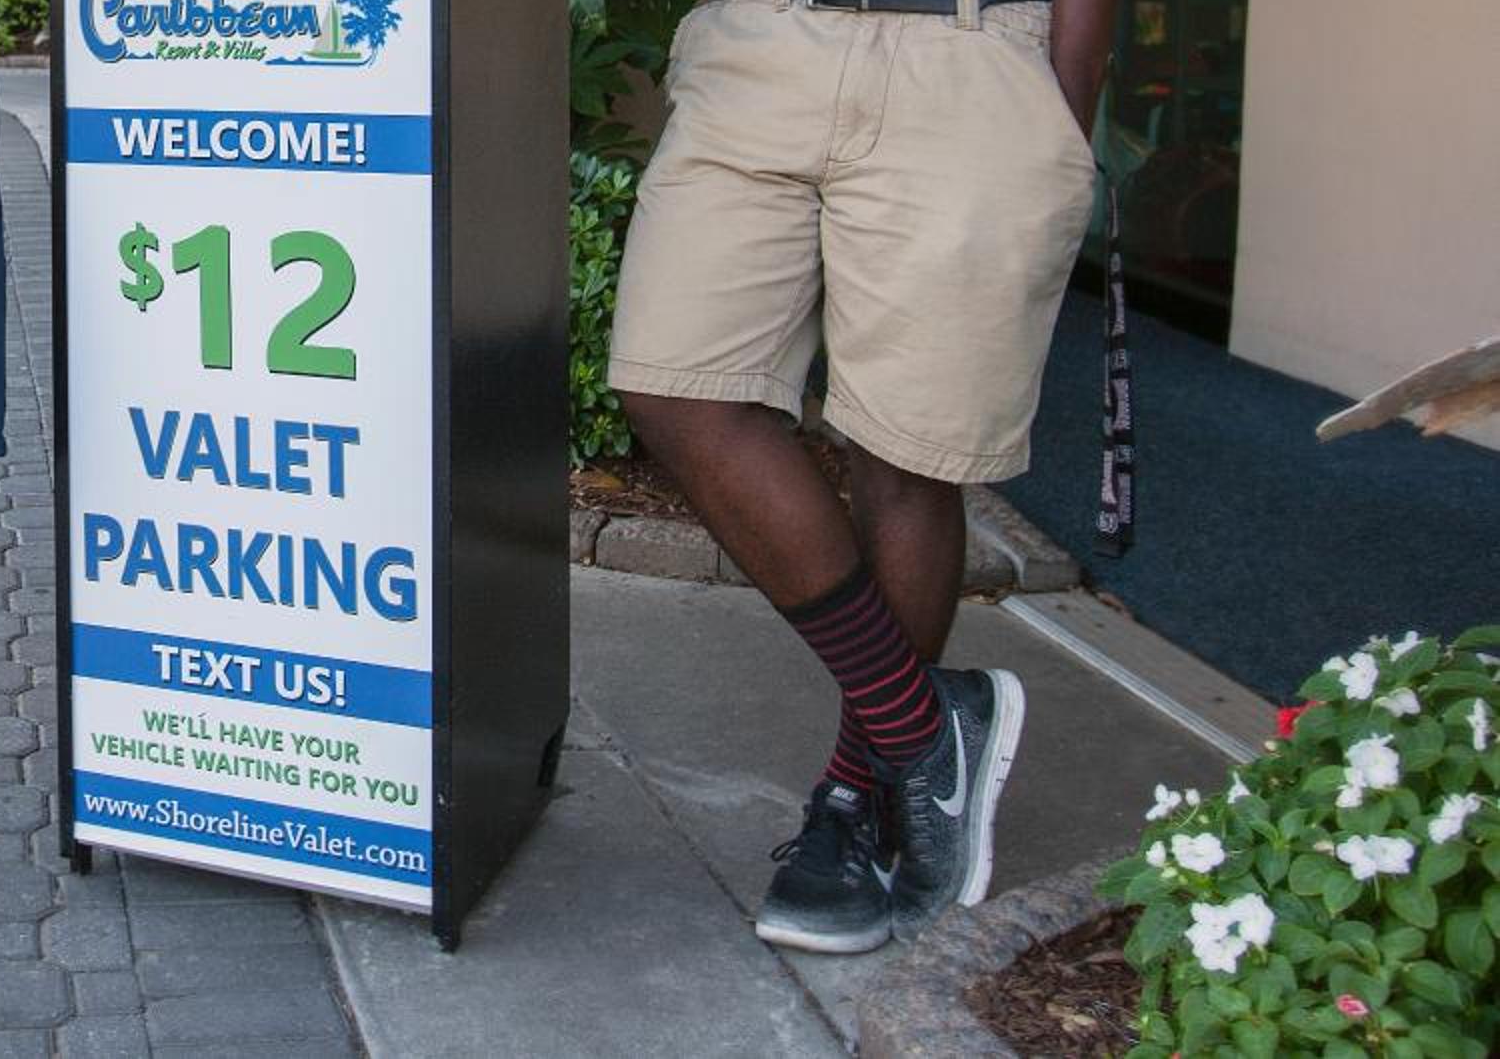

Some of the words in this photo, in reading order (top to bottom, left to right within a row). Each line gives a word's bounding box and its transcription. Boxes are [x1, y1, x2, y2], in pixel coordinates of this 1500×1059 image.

[156, 40, 201, 60] Resort
[203, 41, 220, 59] &
[223, 41, 267, 61] Villas
[112, 117, 367, 164] WELCOME!
[118, 221, 358, 381] $12
[128, 406, 360, 498] VALET
[83, 512, 419, 623] PARKING
[152, 643, 260, 693] TEXT
[274, 662, 347, 707] US!
[90, 732, 186, 768] VEHICLE
[191, 748, 301, 787] WAITING
[309, 768, 358, 798] FOR
[363, 776, 420, 807] YOU
[219, 721, 285, 753] HAVE
[291, 732, 360, 766] YOUR
[84, 793, 426, 872] www.ShorelineValet.com
